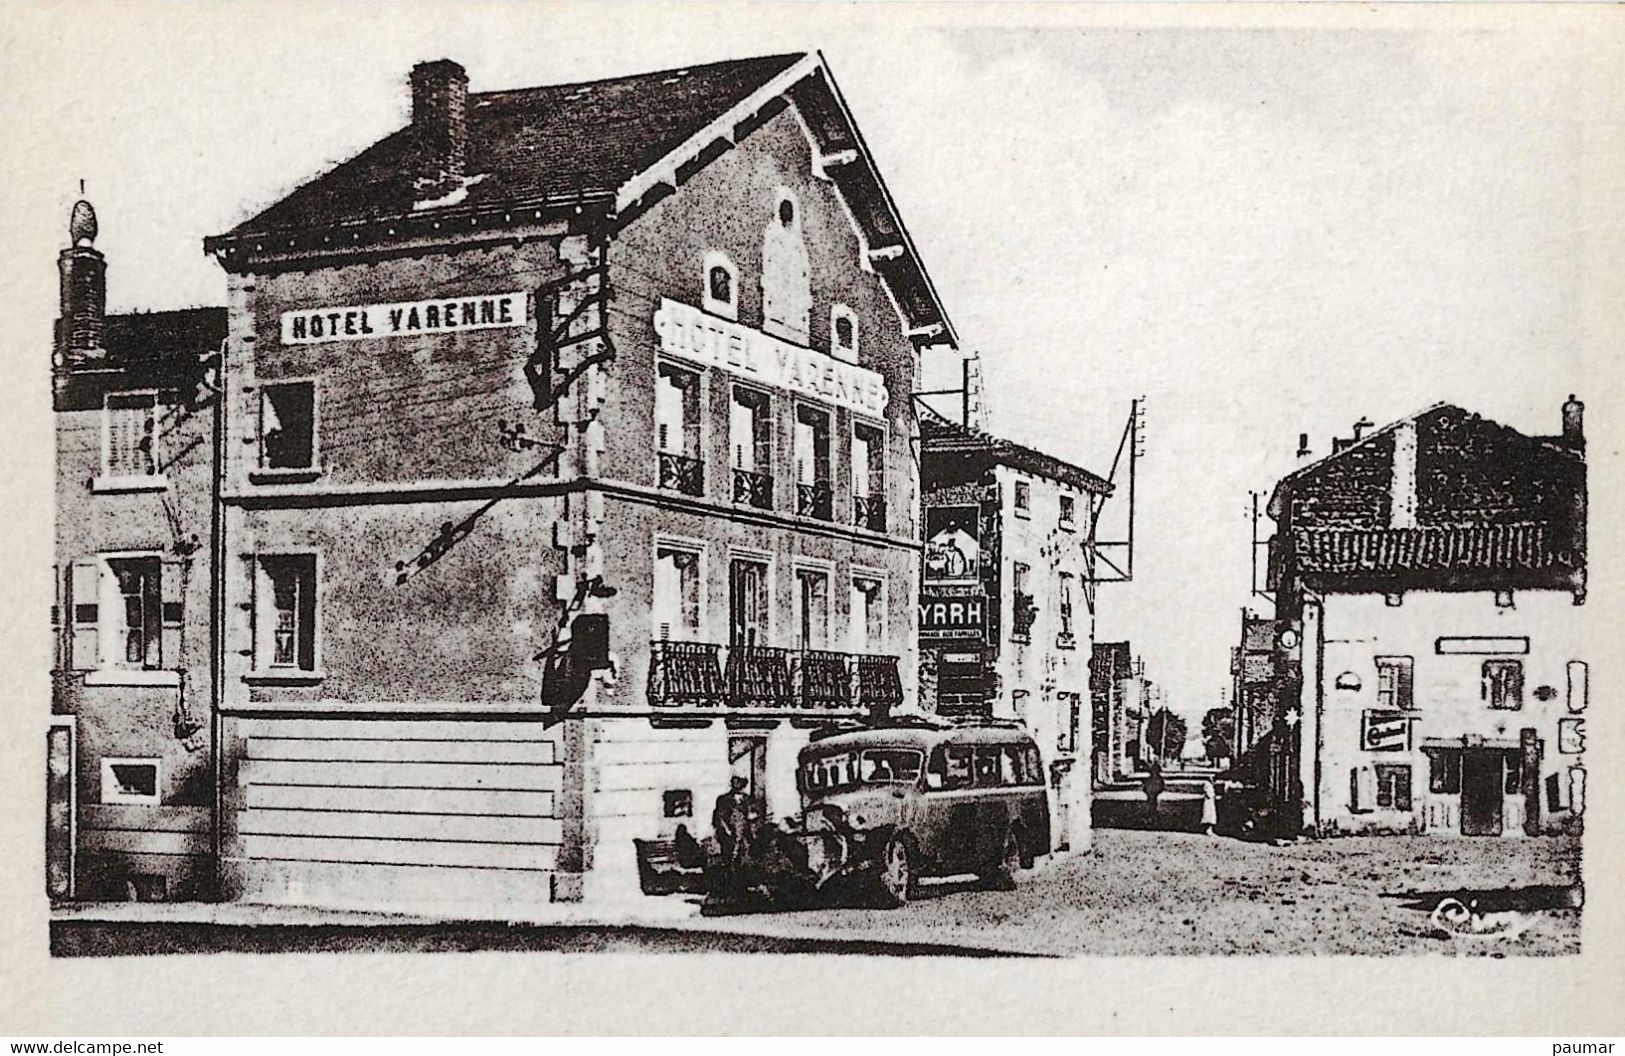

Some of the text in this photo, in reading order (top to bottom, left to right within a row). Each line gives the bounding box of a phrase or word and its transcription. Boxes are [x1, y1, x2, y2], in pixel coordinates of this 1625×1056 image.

[293, 298, 512, 339] HOTEL VARENNE
[669, 306, 878, 411] HOTEL VARENNE
